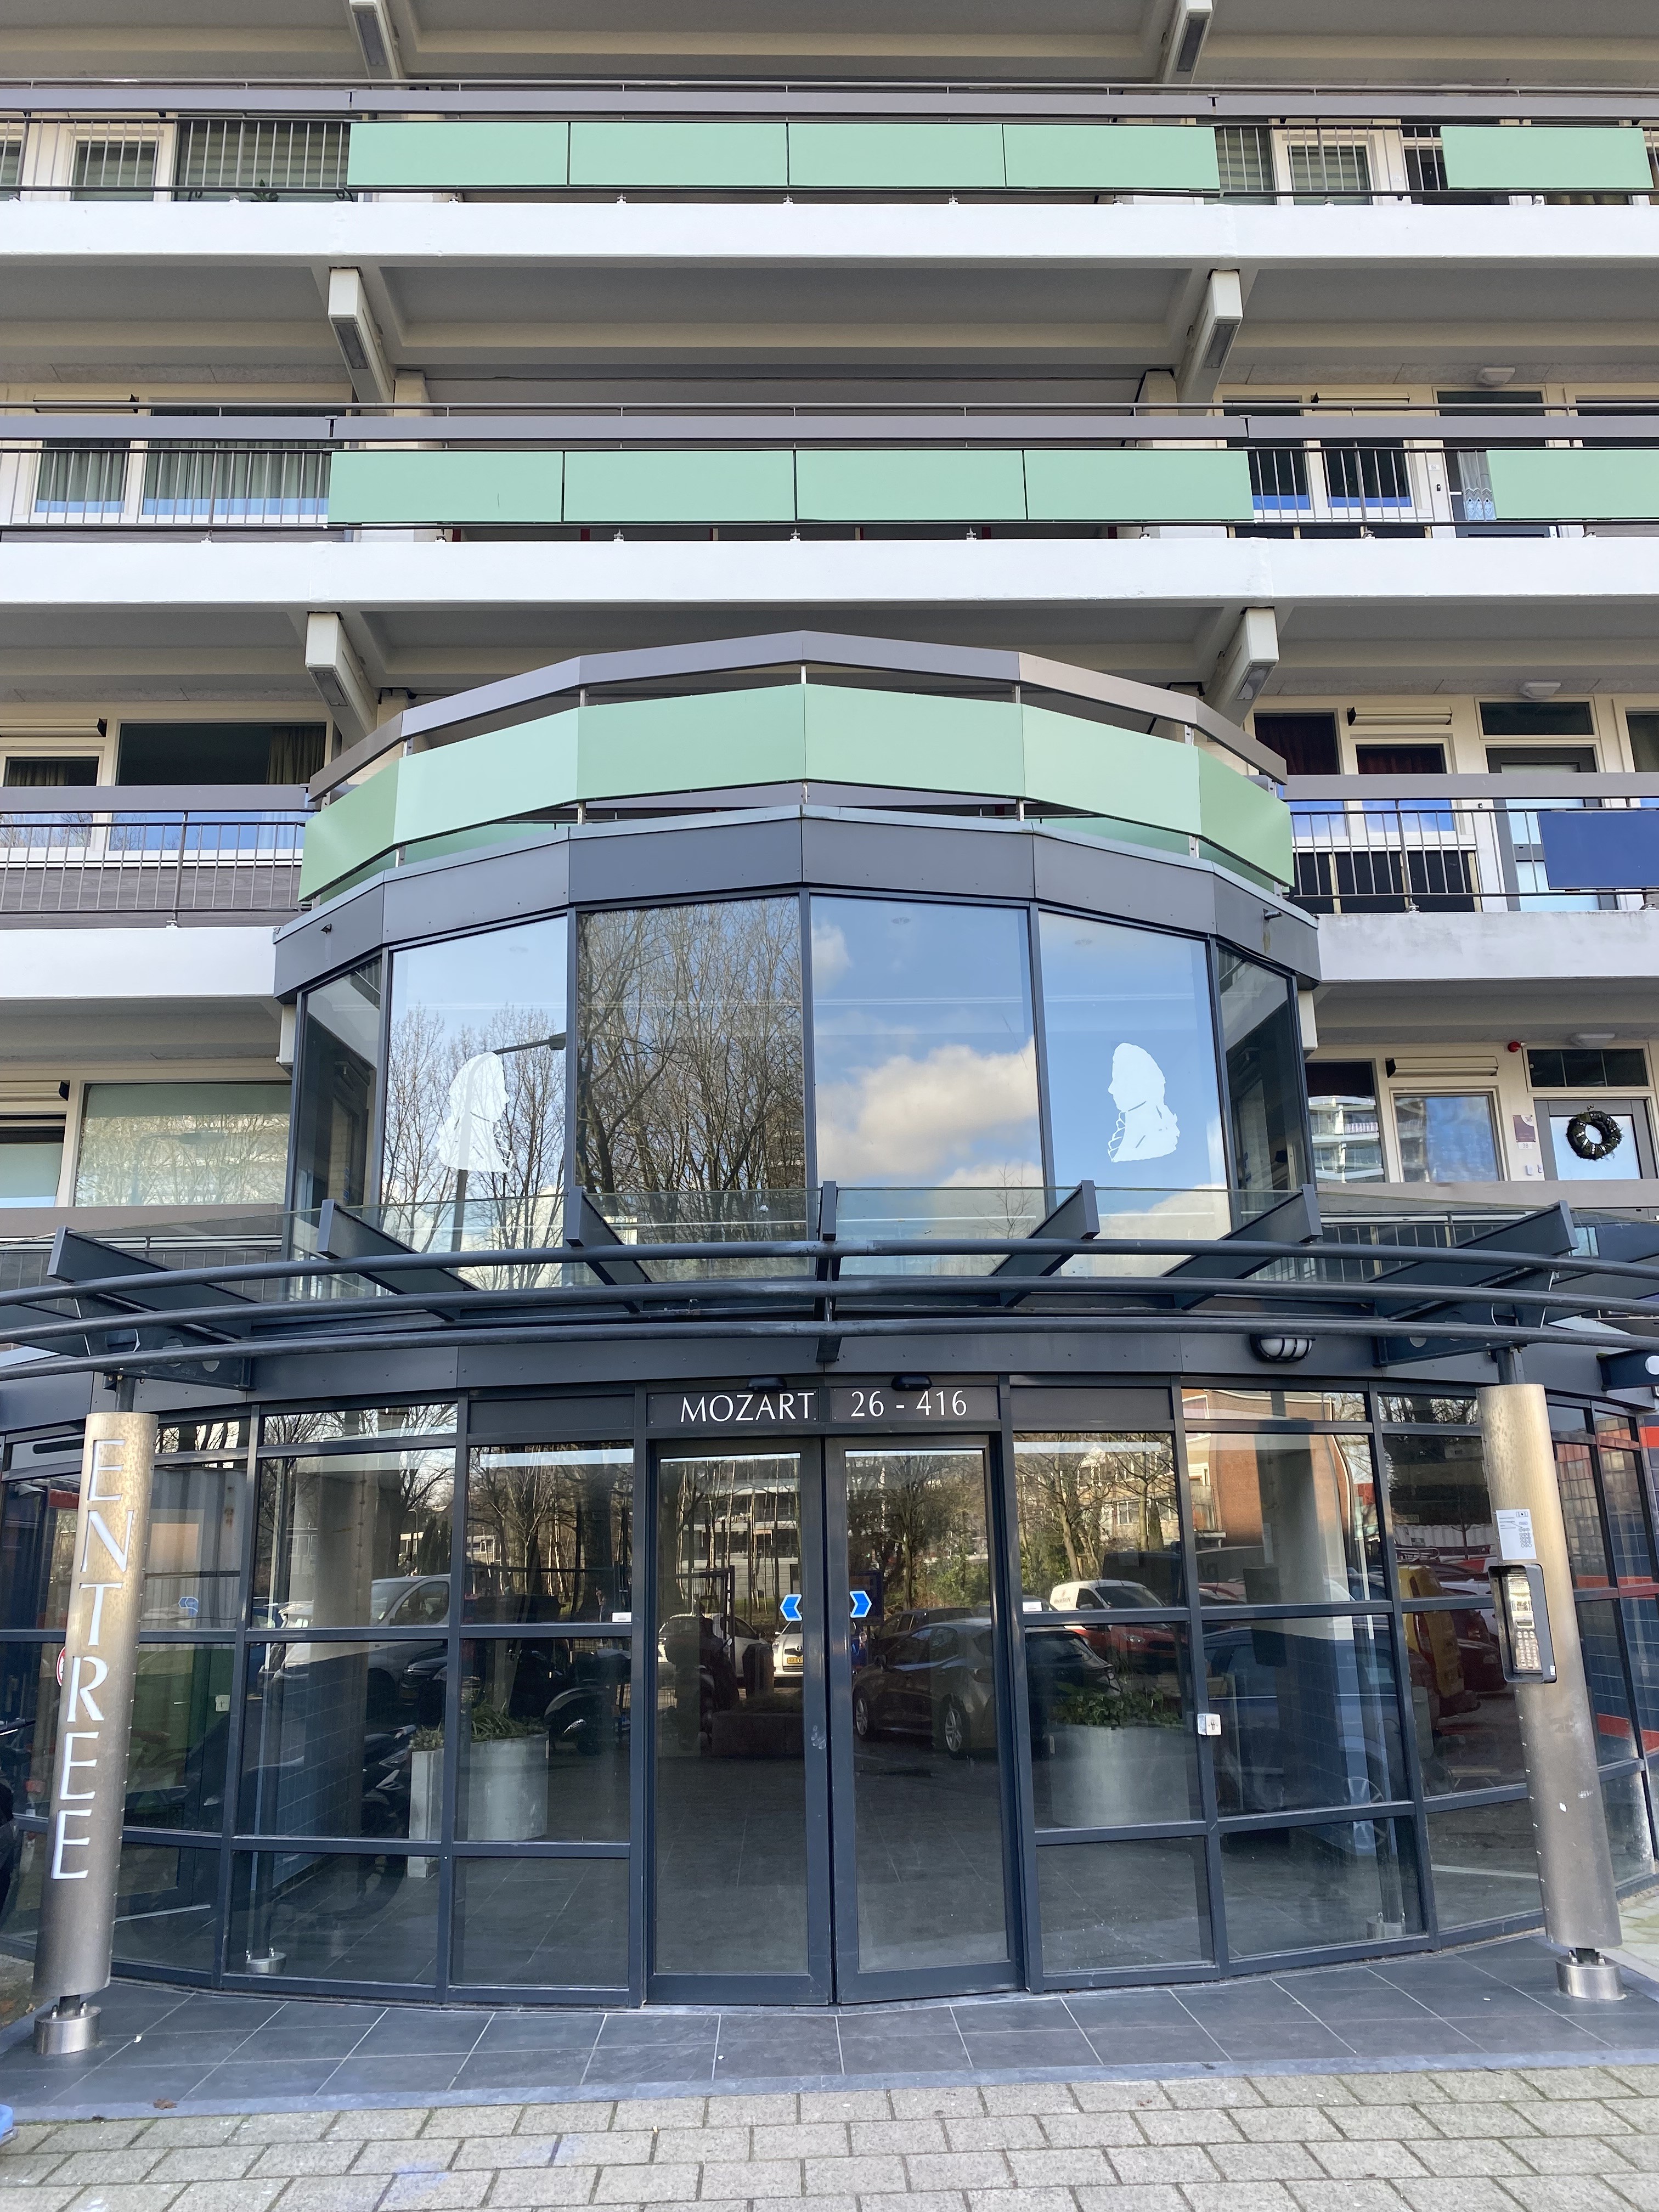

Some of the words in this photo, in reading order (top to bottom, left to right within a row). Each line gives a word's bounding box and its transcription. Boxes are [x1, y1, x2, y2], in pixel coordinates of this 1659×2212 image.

[680, 1392, 815, 1423] MOZART
[850, 1391, 884, 1417] 26
[916, 1390, 967, 1416] 416
[50, 1438, 134, 1881] ENTREE
